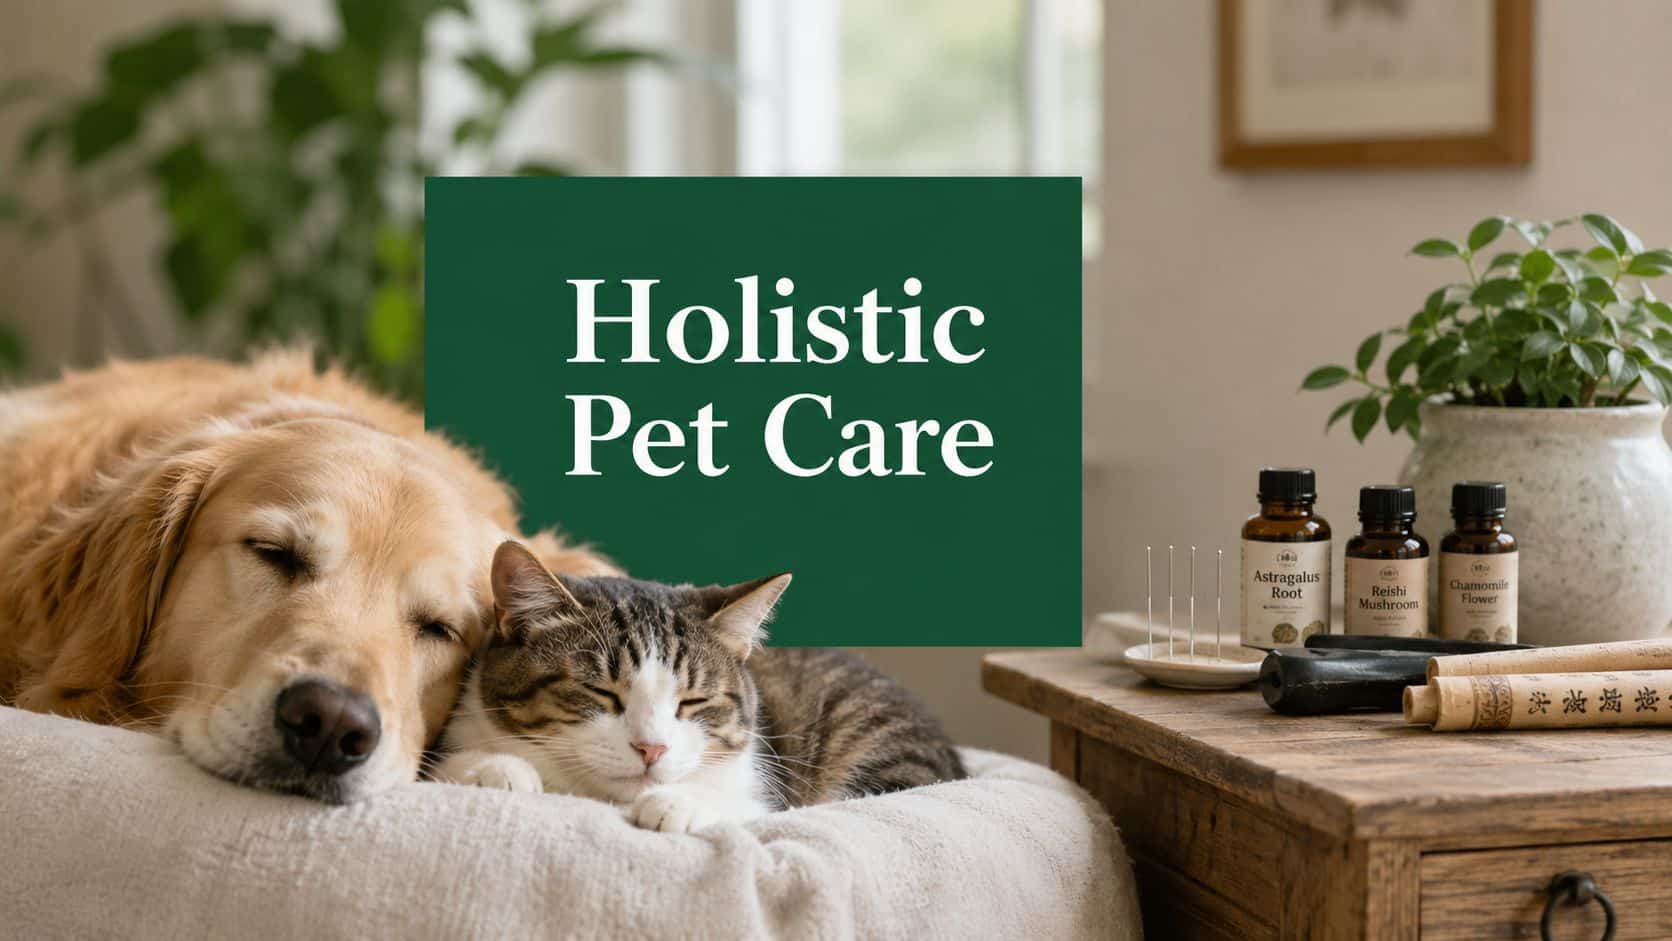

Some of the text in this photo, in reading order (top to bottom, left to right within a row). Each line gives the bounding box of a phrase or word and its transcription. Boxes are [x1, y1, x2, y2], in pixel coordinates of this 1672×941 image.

[1254, 570, 1321, 586] Astragalus
[1371, 585, 1407, 597] Reishi
[1449, 579, 1509, 591] Chamomile
[1271, 586, 1303, 599] Root
[1461, 592, 1499, 604] Flower
[1358, 597, 1419, 610] Mushroom
